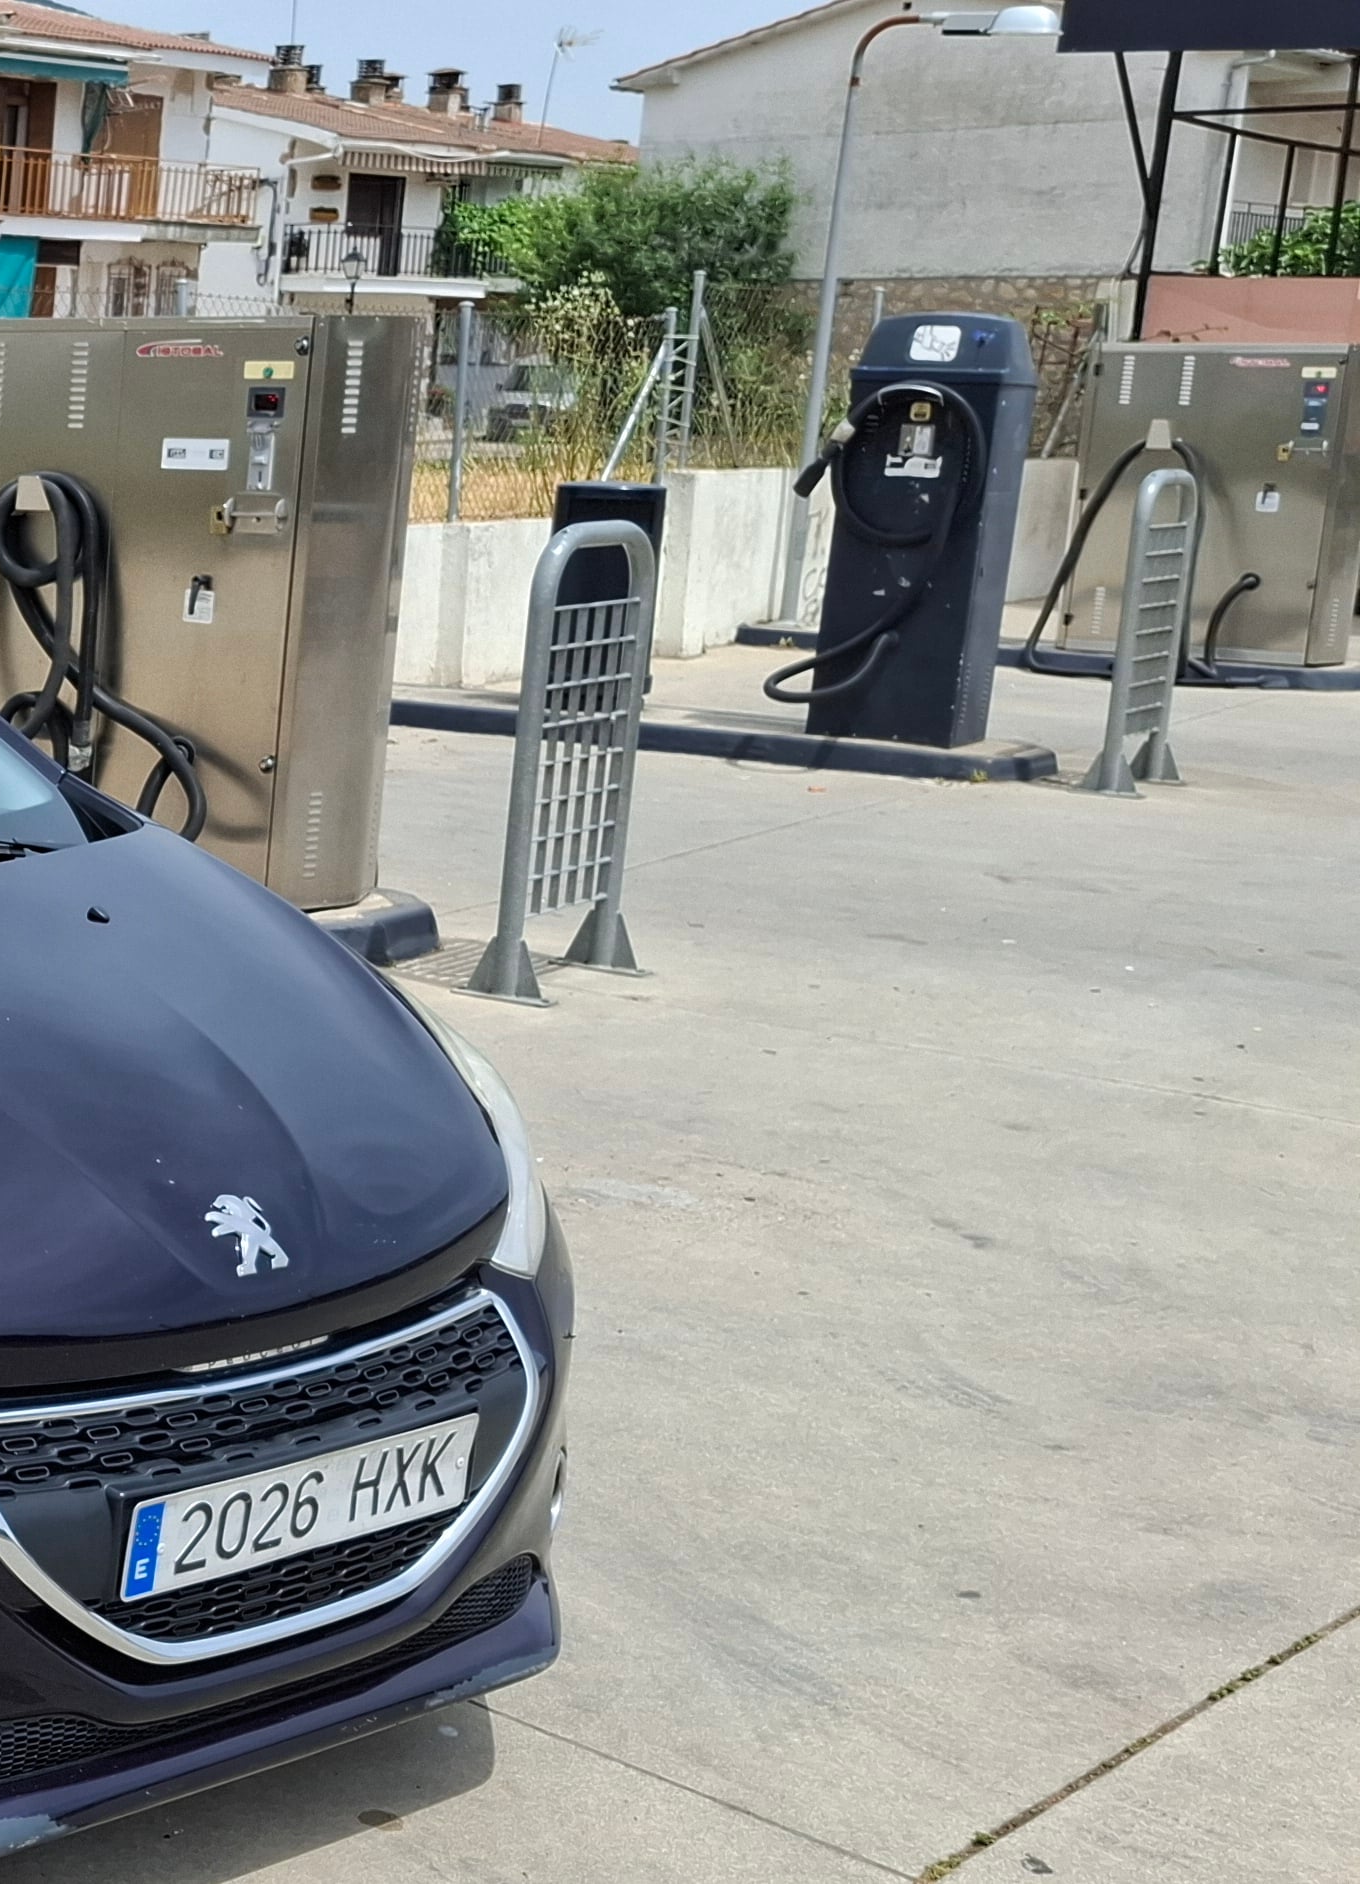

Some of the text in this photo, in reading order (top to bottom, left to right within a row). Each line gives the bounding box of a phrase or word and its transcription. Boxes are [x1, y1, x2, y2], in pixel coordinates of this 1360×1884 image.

[173, 1429, 459, 1575] 2026 HXK
[134, 1557, 150, 1580] E
